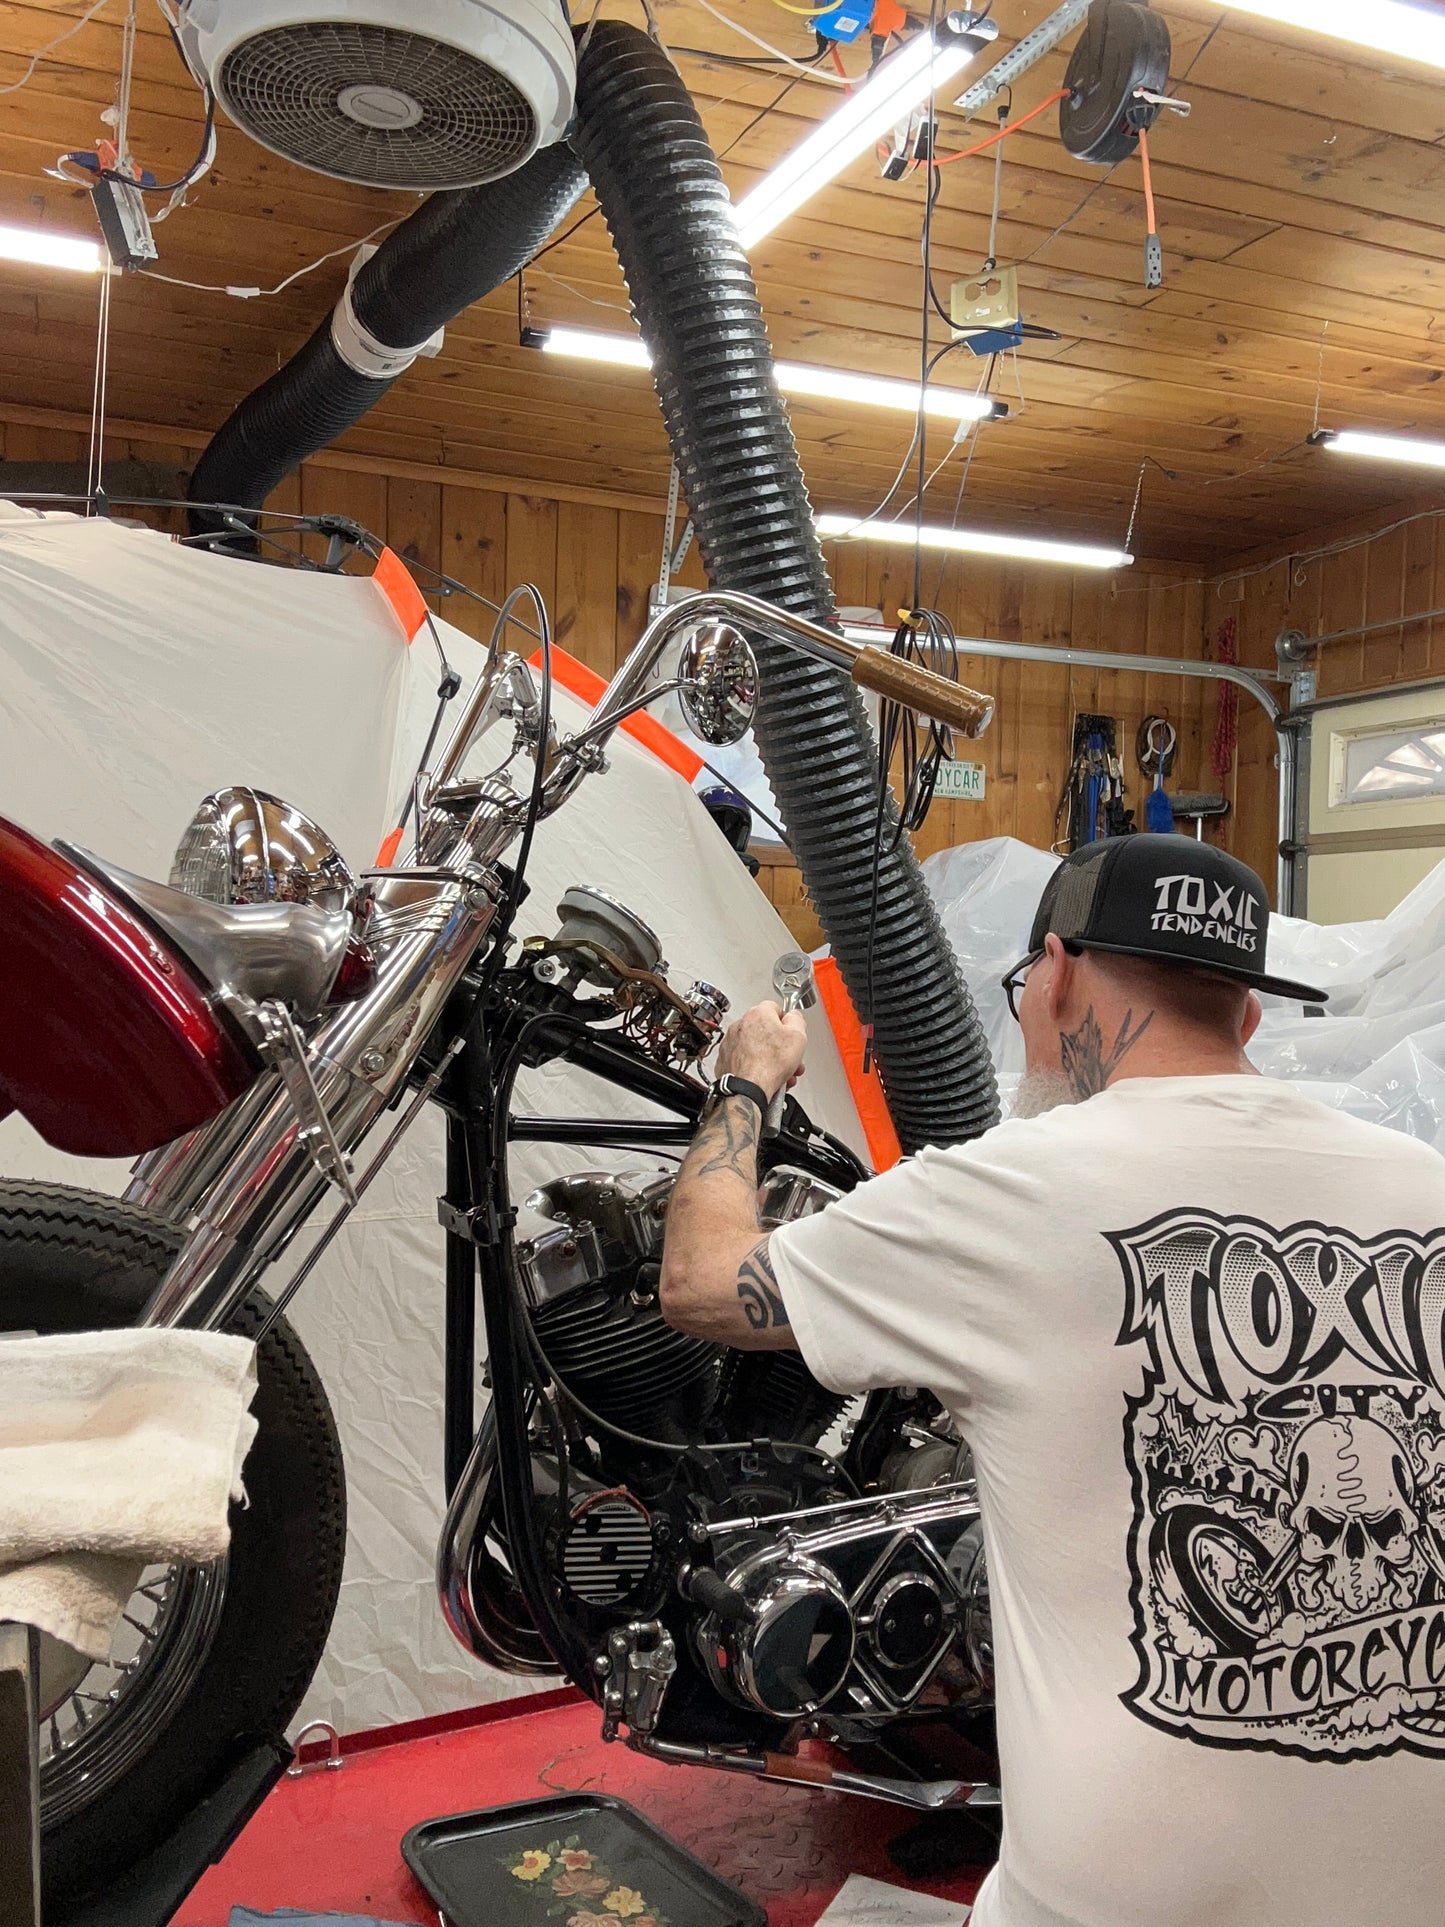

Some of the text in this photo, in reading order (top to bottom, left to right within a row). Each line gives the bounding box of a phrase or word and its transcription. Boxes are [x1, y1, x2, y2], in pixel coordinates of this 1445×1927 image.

[934, 768, 980, 790] OYCAR
[1154, 875, 1260, 930] TOXIC
[1151, 912, 1257, 952] TENDENCIES
[1256, 1384, 1427, 1420] CITY
